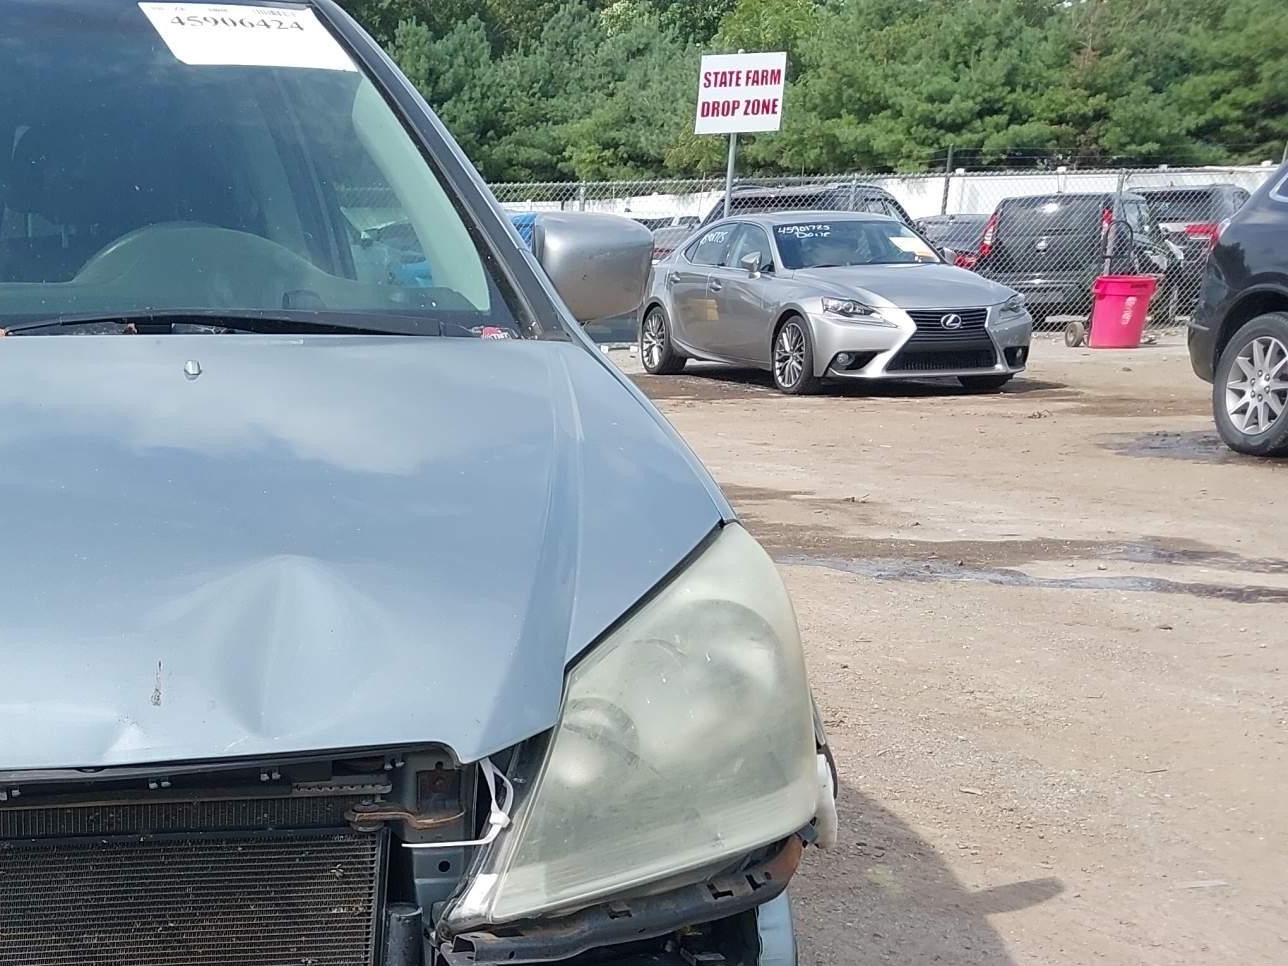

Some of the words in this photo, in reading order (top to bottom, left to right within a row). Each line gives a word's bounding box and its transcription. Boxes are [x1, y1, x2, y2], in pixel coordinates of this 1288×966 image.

[170, 15, 305, 32] 45906424
[703, 70, 742, 88] STATE
[745, 68, 781, 87] FARM
[700, 100, 740, 118] DROP
[743, 98, 779, 116] ZONE
